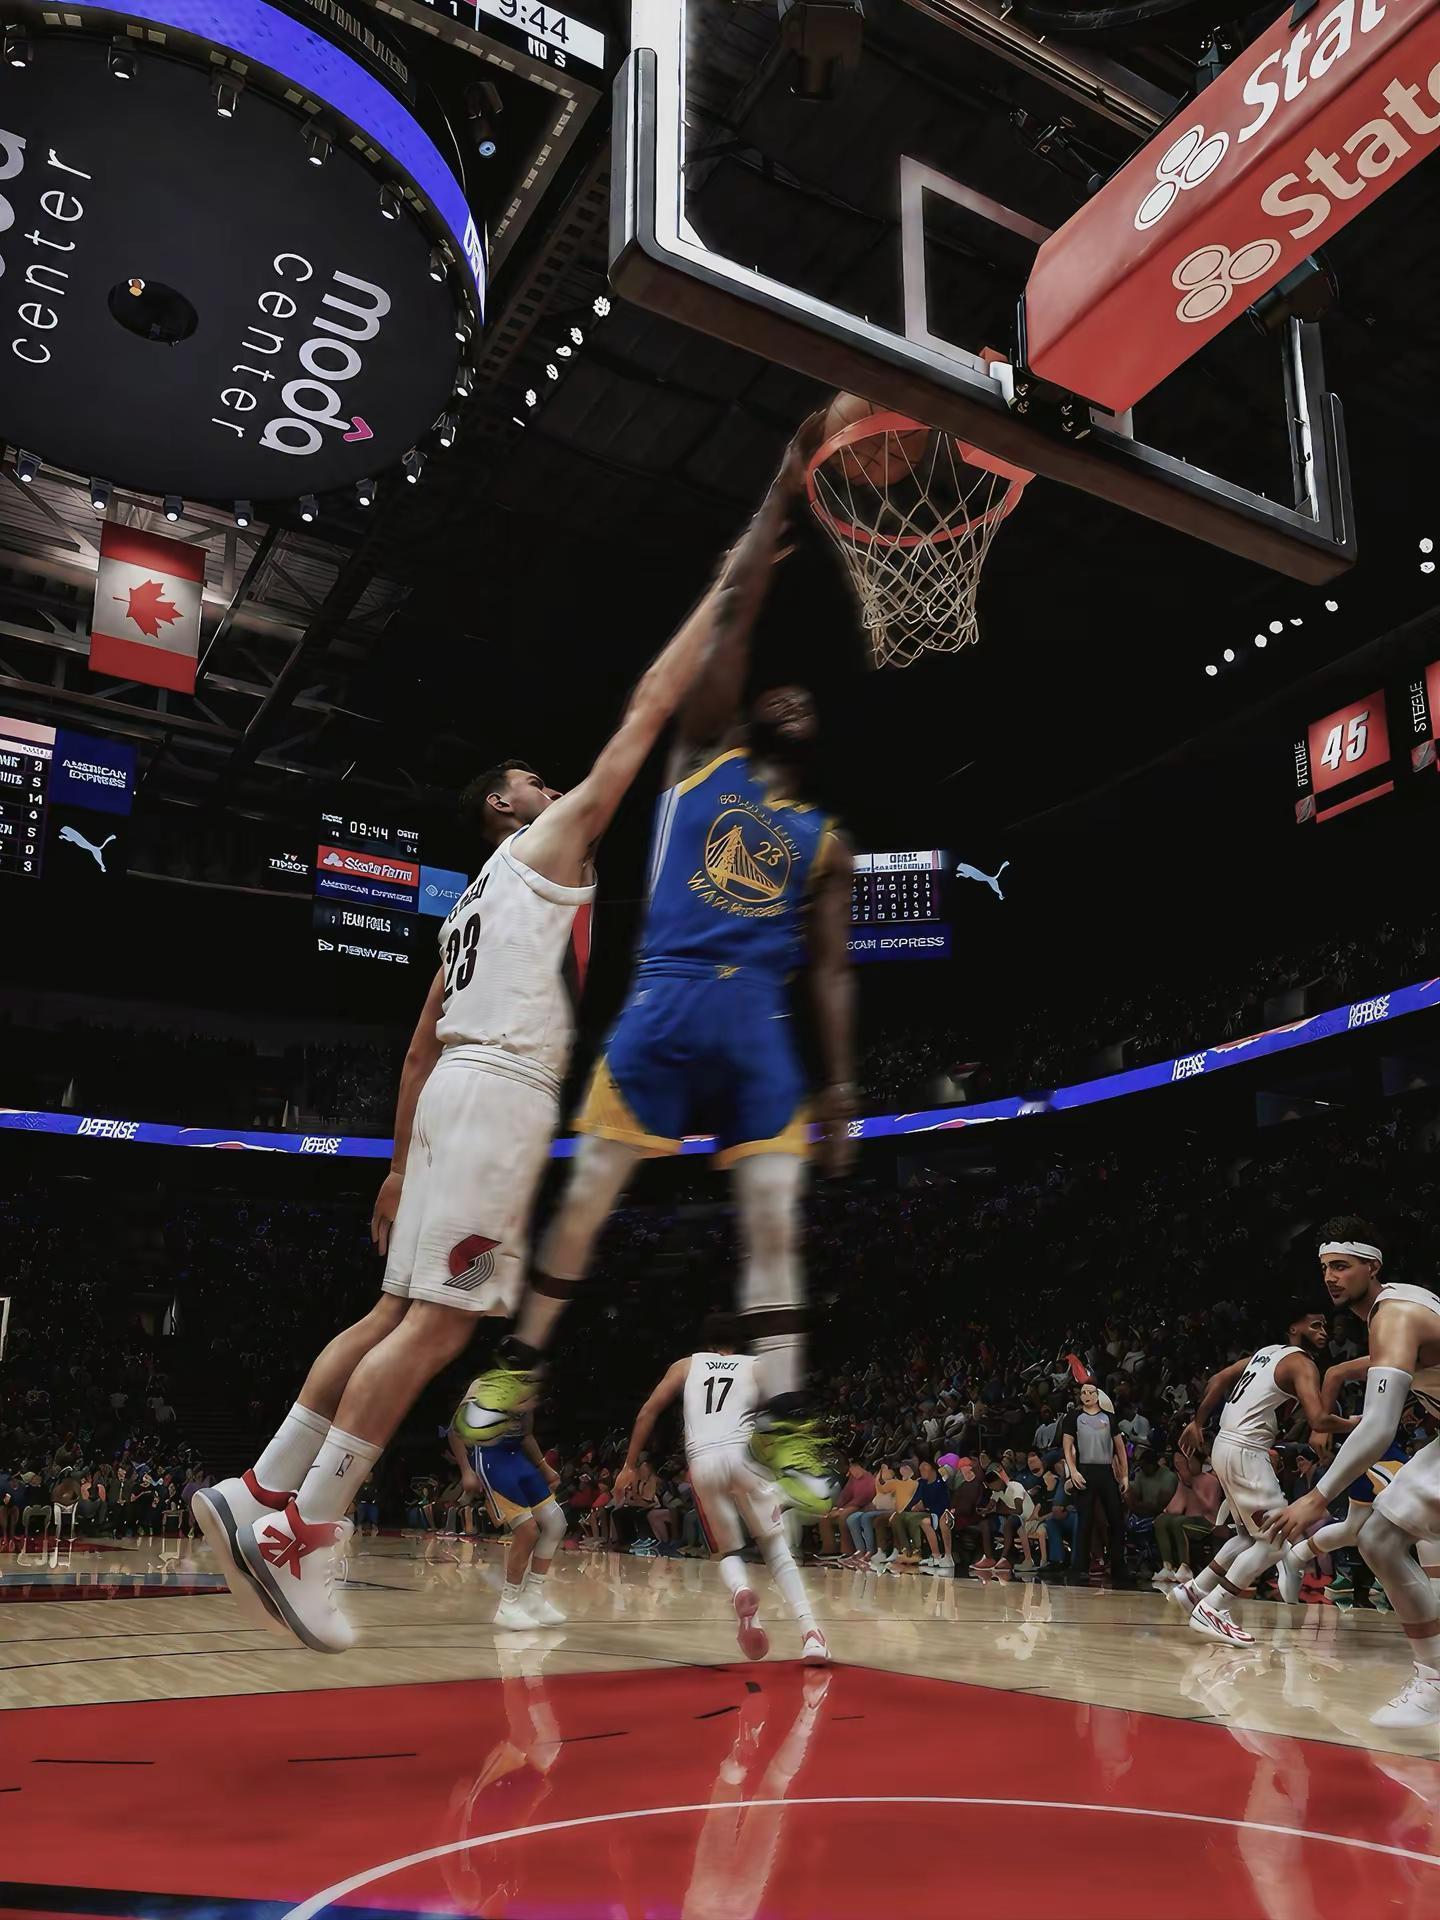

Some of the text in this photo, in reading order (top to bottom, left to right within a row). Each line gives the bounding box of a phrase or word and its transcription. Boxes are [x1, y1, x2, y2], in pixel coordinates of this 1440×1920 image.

[12, 148, 92, 364] center
[212, 252, 313, 438] center
[259, 270, 391, 456] moda
[1320, 710, 1369, 770] 45
[350, 821, 389, 840] 09:44
[752, 841, 784, 866] 23
[443, 912, 481, 1003] 23
[880, 937, 945, 949] EXPRESS
[77, 1117, 140, 1140] DEFENSE
[703, 1376, 734, 1415] 17
